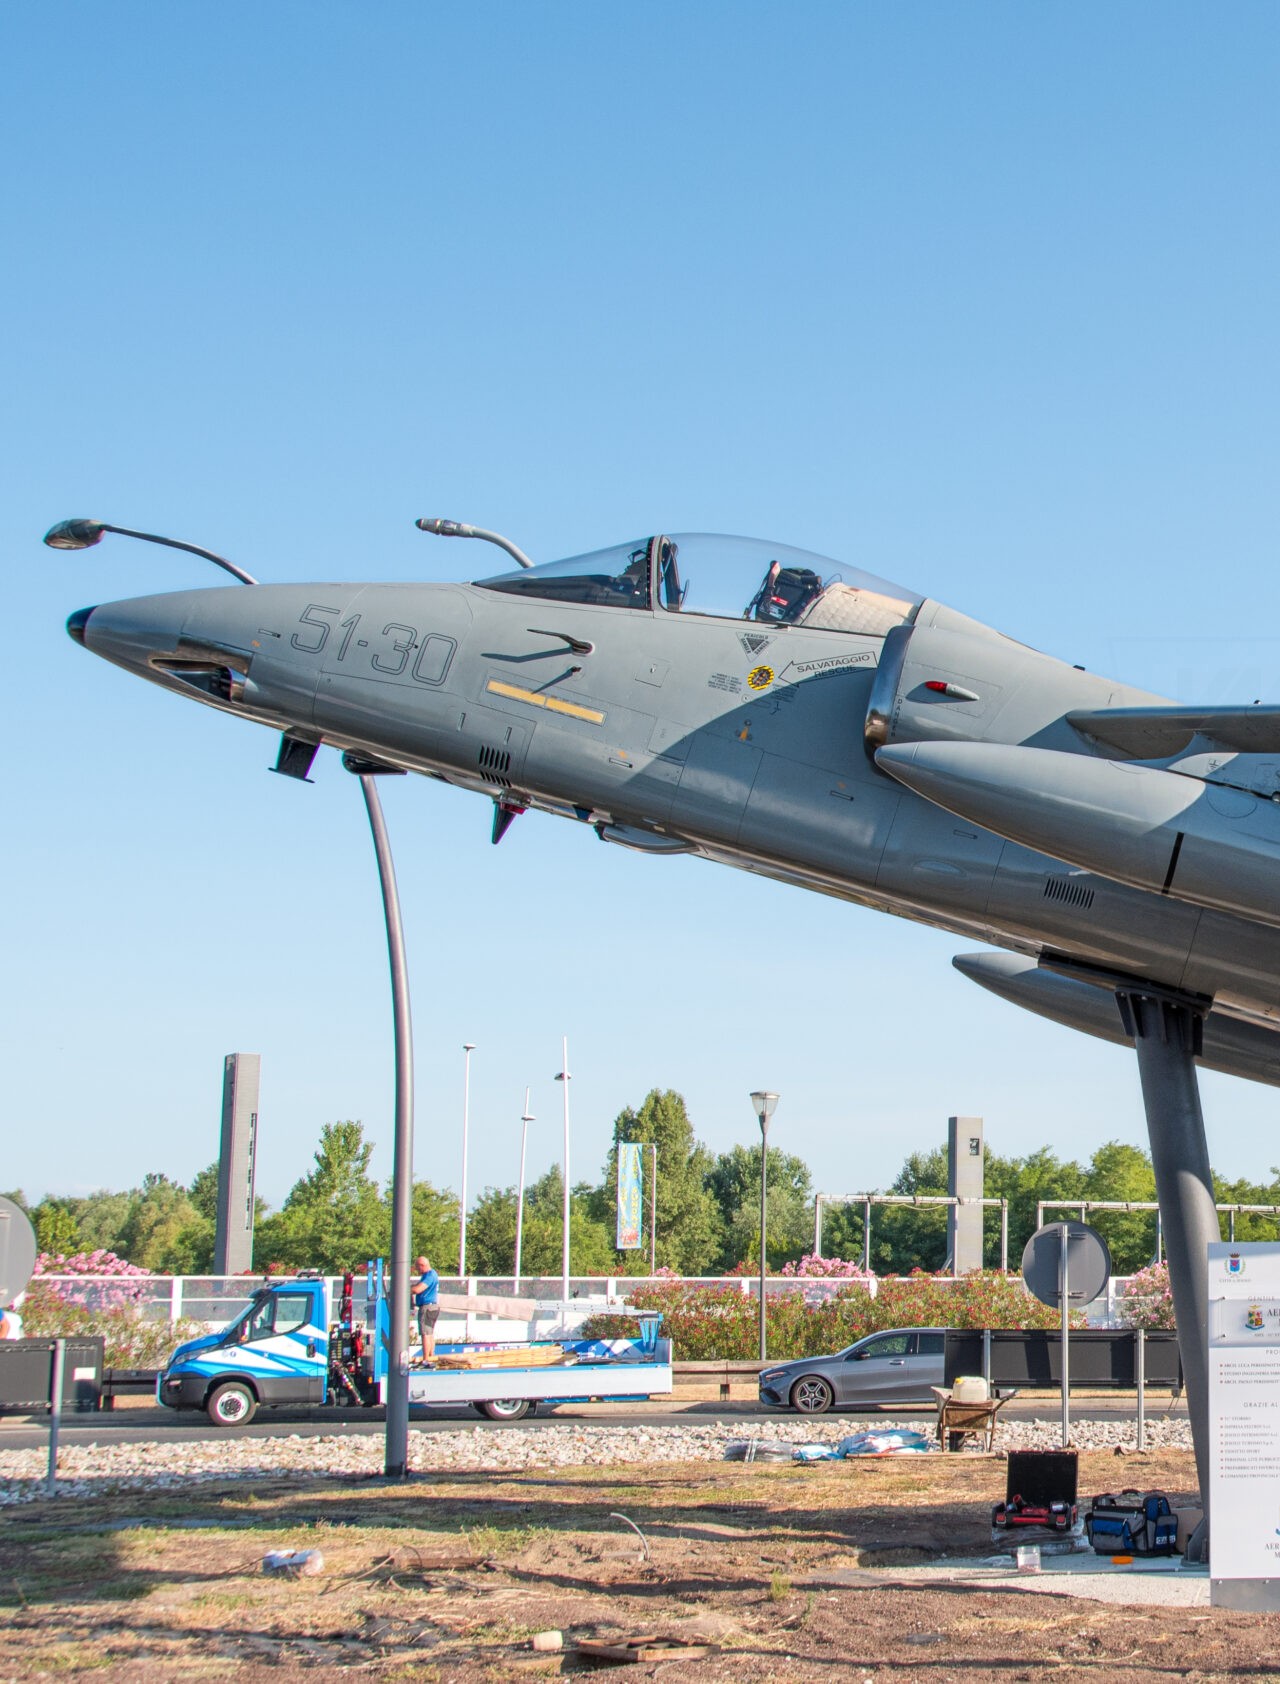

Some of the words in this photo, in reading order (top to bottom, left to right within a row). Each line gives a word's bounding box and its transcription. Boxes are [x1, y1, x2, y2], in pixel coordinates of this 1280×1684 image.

[290, 603, 458, 687] 51-30
[797, 654, 870, 673] SALVATAGGIO
[814, 664, 856, 678] RESCUE
